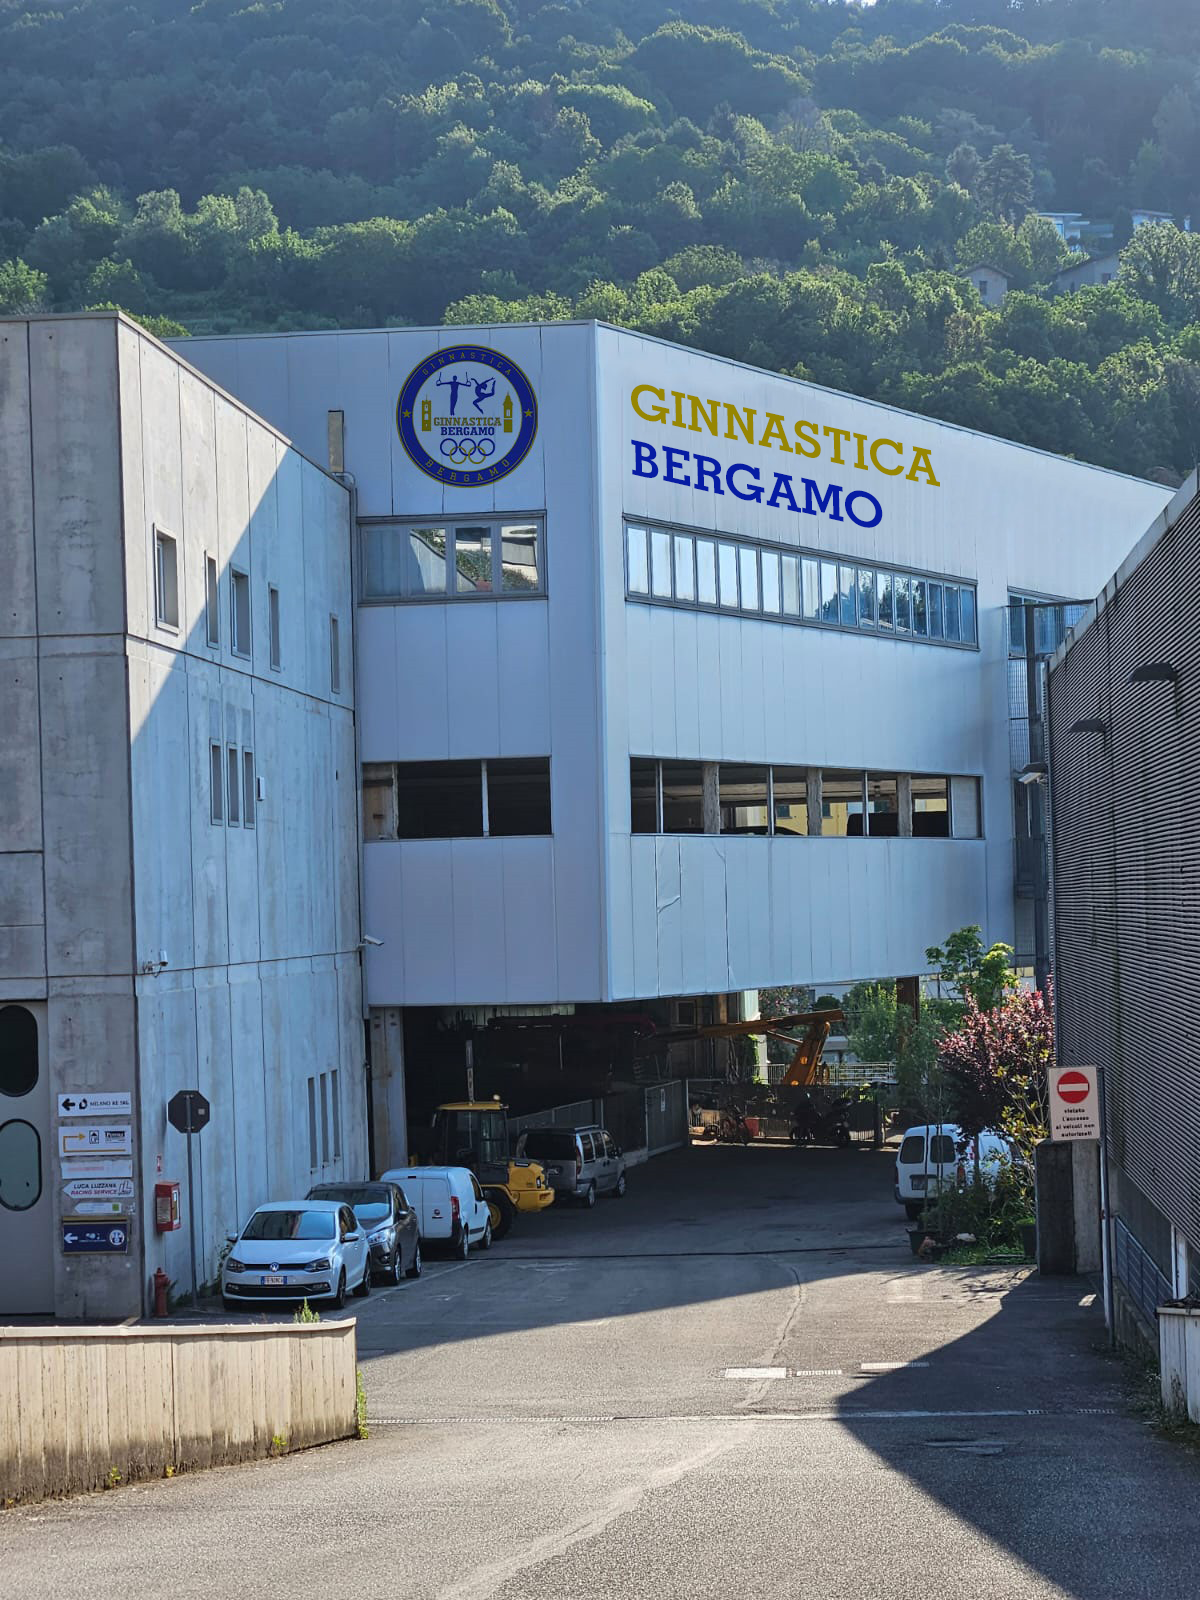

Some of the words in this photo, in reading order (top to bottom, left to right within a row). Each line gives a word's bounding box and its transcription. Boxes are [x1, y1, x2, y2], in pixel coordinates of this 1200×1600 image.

[422, 352, 512, 376] GINNASTICA
[433, 417, 502, 427] GINNASTICA
[440, 426, 495, 436] BERGAMO
[631, 384, 940, 487] GINNASTICA
[424, 459, 510, 482] BERGAMO
[631, 439, 883, 528] BERGAMO
